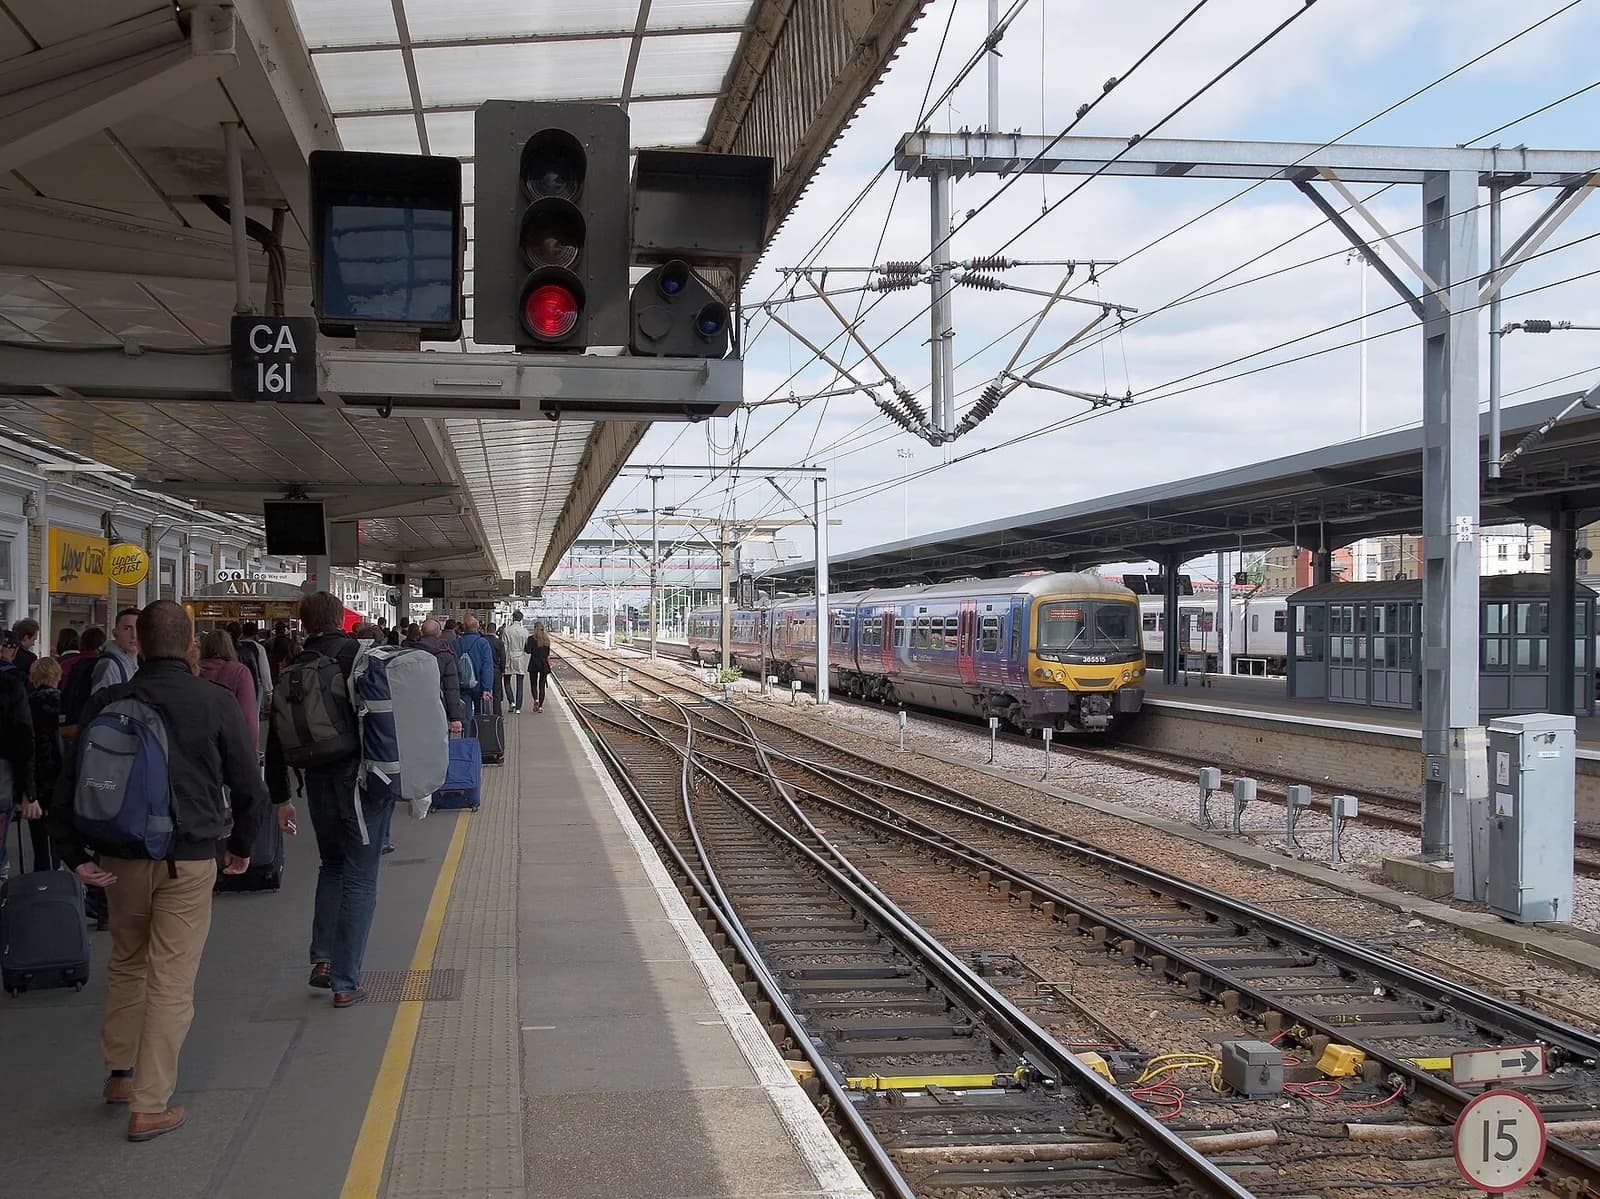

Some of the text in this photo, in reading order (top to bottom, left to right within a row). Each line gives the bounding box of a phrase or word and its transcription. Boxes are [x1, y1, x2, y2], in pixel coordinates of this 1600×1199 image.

[249, 324, 297, 354] CA
[257, 363, 292, 393] 161
[226, 582, 272, 595] AMT
[1082, 656, 1107, 664] 365515
[1482, 1119, 1518, 1163] 15
